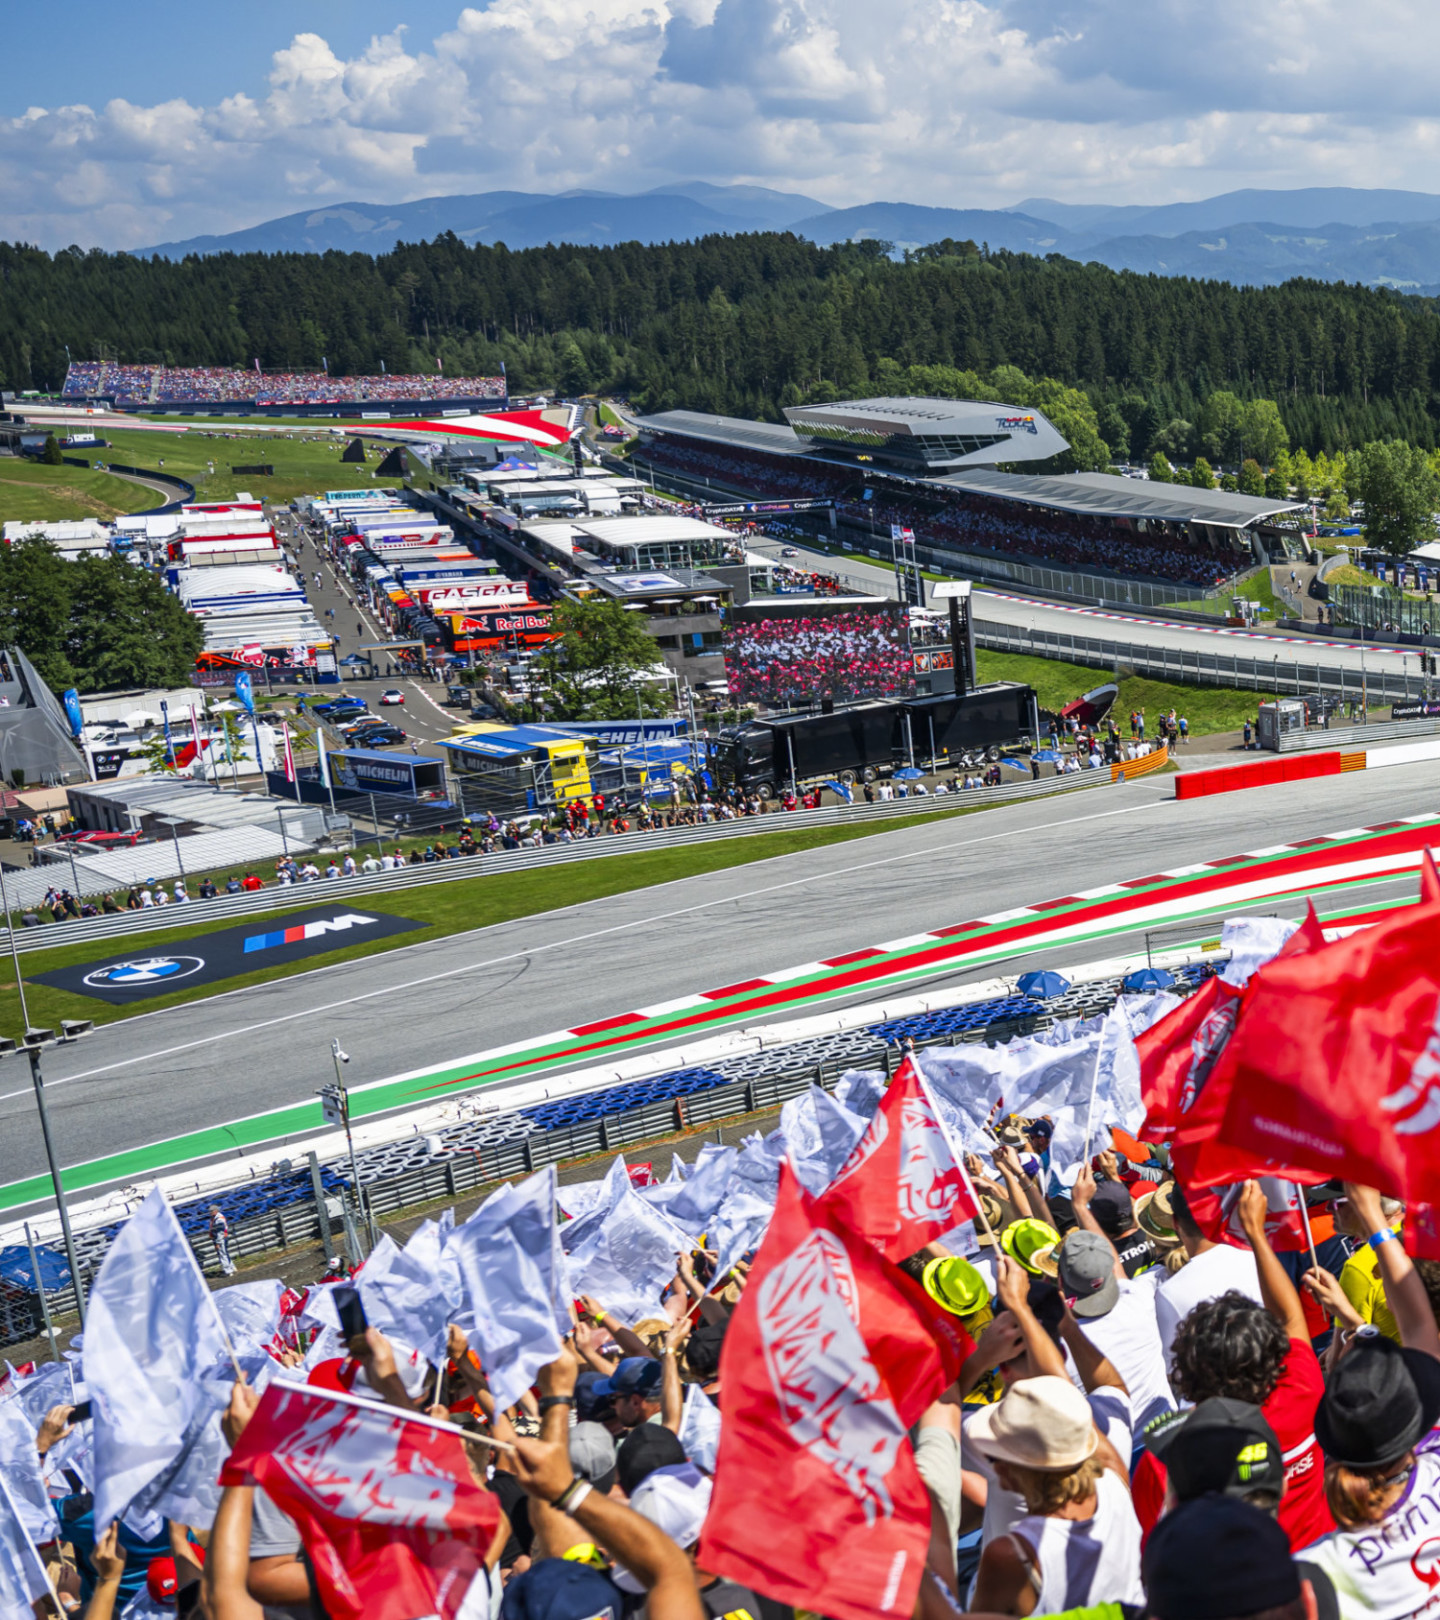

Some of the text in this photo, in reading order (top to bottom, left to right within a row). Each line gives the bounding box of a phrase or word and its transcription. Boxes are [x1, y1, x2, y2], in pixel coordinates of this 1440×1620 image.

[428, 583, 527, 601] GASGAS
[495, 616, 524, 631] Red
[597, 730, 672, 744] CHELIN
[357, 764, 409, 783] MICHELIN
[467, 758, 516, 777] MICHELIN
[1236, 1441, 1268, 1463] 46
